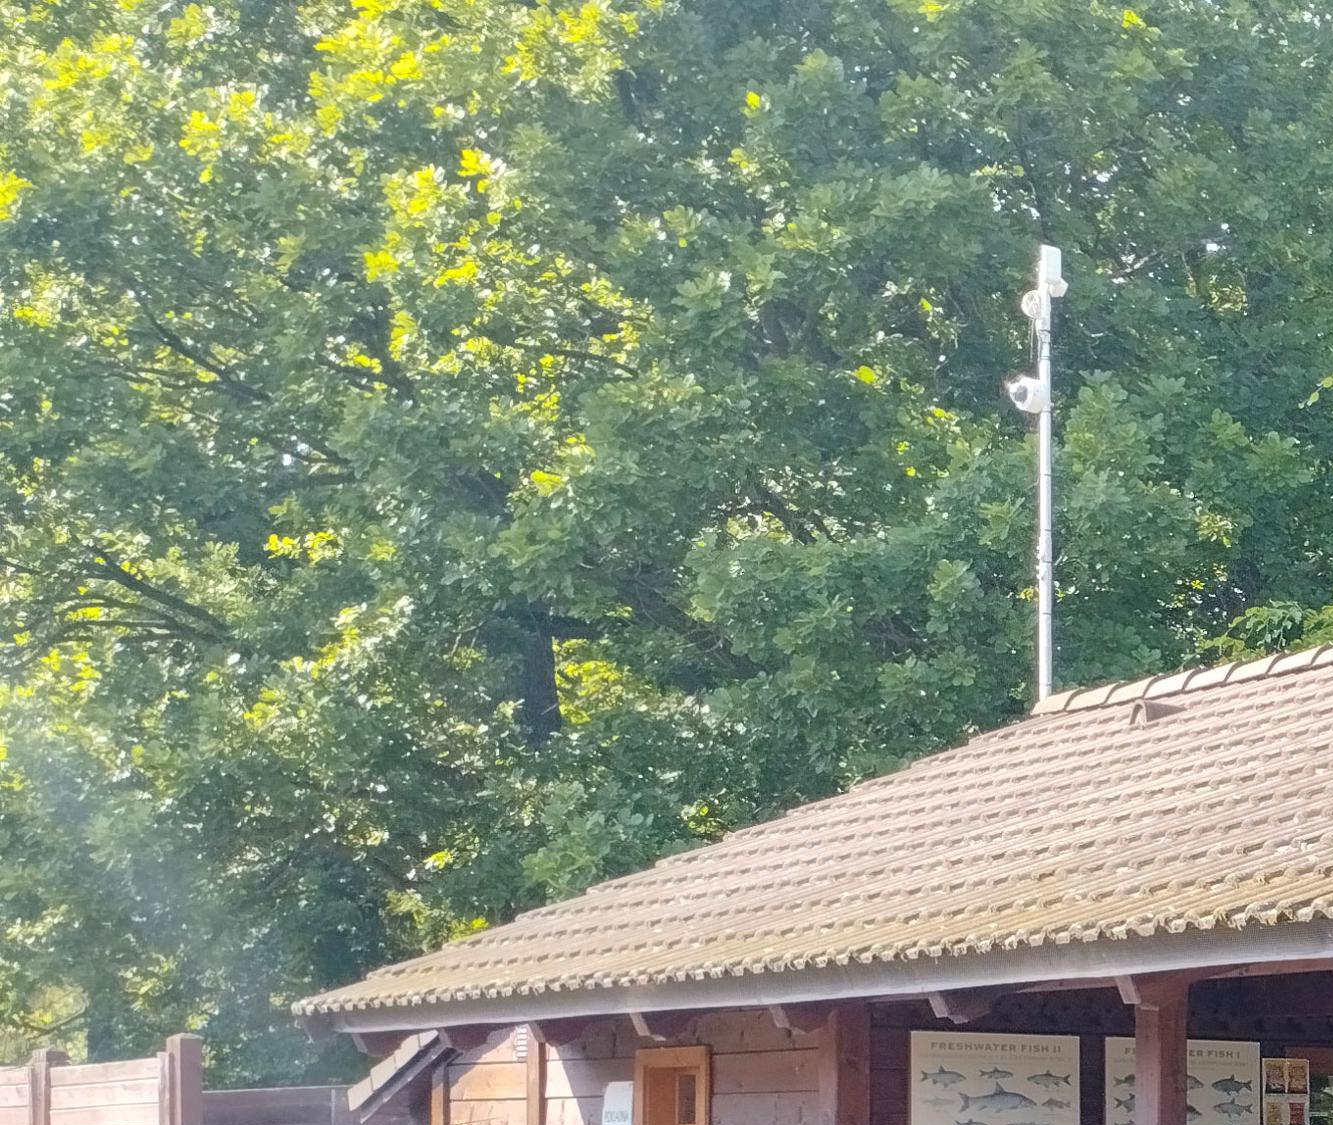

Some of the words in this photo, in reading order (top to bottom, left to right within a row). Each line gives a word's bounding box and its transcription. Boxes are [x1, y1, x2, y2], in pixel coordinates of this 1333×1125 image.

[930, 1041, 1018, 1053] FRESHWATER
[1020, 1043, 1050, 1054] FISH
[1207, 1049, 1234, 1060] FISH
